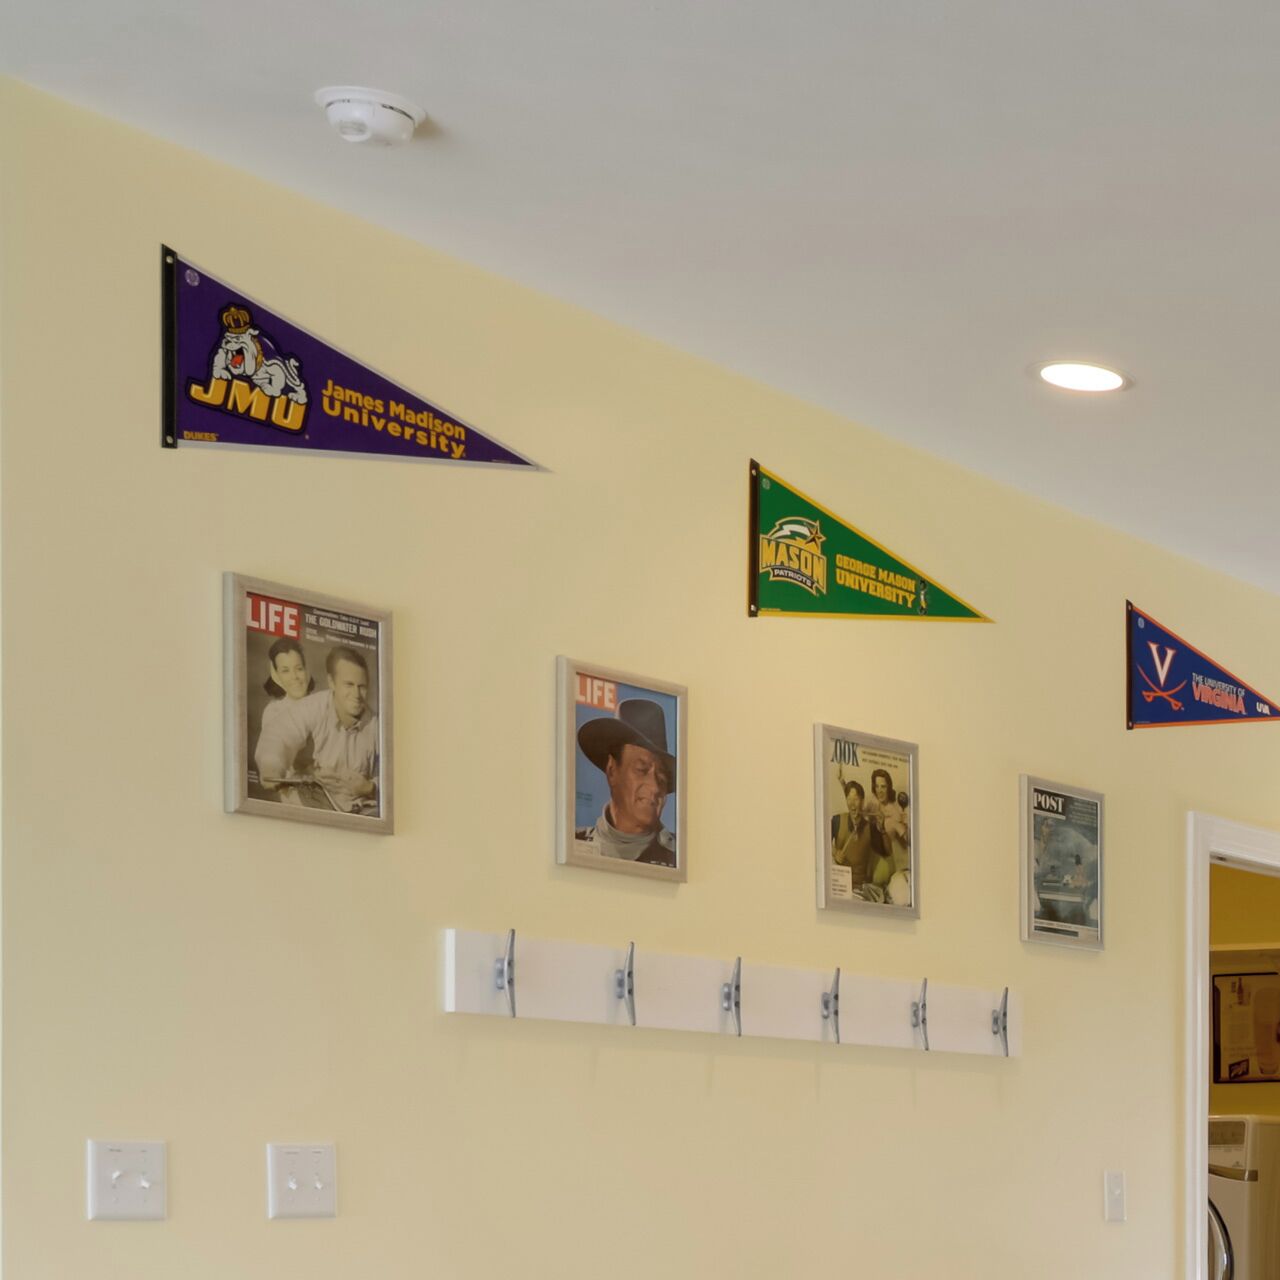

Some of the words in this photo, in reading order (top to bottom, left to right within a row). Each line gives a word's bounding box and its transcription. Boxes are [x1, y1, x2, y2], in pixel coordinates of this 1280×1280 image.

[190, 377, 306, 430] JMU
[322, 379, 384, 414] James
[388, 399, 466, 441] Madison
[322, 395, 466, 459] University
[761, 537, 825, 587] MASON
[773, 568, 813, 587] PATRIOTS
[835, 553, 878, 579] GEORGE
[878, 567, 916, 593] MASON
[835, 567, 917, 608] UNIVERSITY
[247, 598, 298, 637] LIFE
[576, 674, 615, 709] LIFE
[1192, 672, 1203, 684] THE
[1205, 676, 1237, 695] UNIVERSITY
[1192, 681, 1247, 714] VIRGINIA
[1034, 792, 1064, 813] POST
